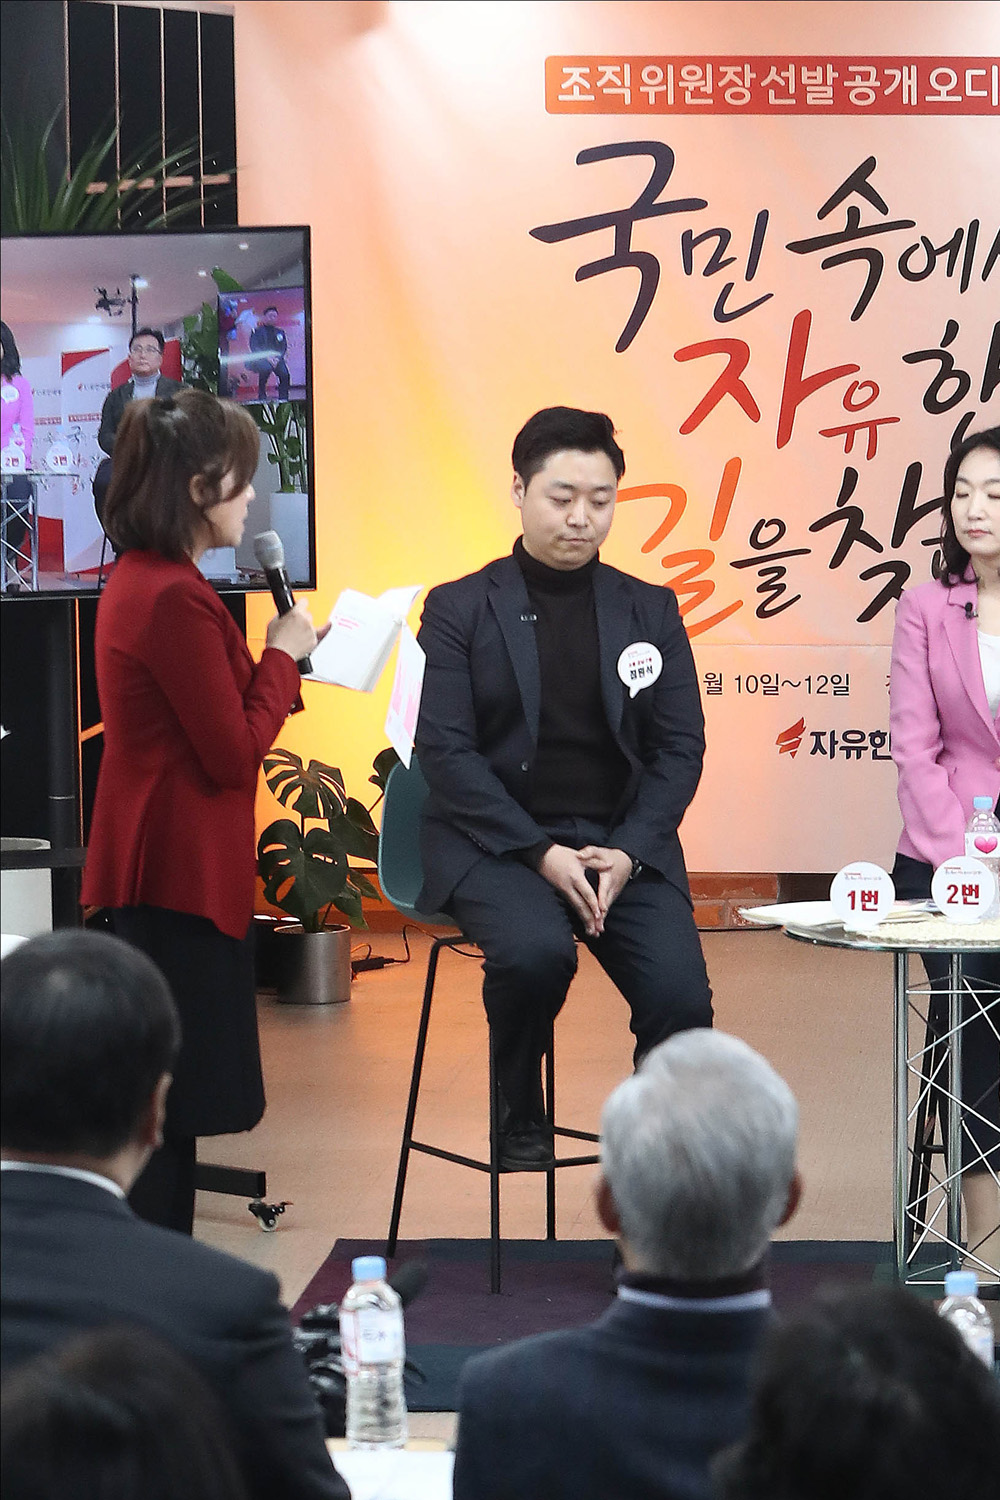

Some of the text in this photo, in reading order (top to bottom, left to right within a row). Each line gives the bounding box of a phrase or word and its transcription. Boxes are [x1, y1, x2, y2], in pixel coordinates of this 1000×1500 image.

[761, 63, 839, 105] 선발
[843, 64, 918, 105] 공개
[528, 140, 775, 354] 국민
[616, 456, 946, 639] 길을 찾
[735, 673, 850, 696] 10일~12일
[810, 729, 892, 760] 자유한
[847, 889, 879, 912] 1번
[946, 884, 980, 906] 2번
